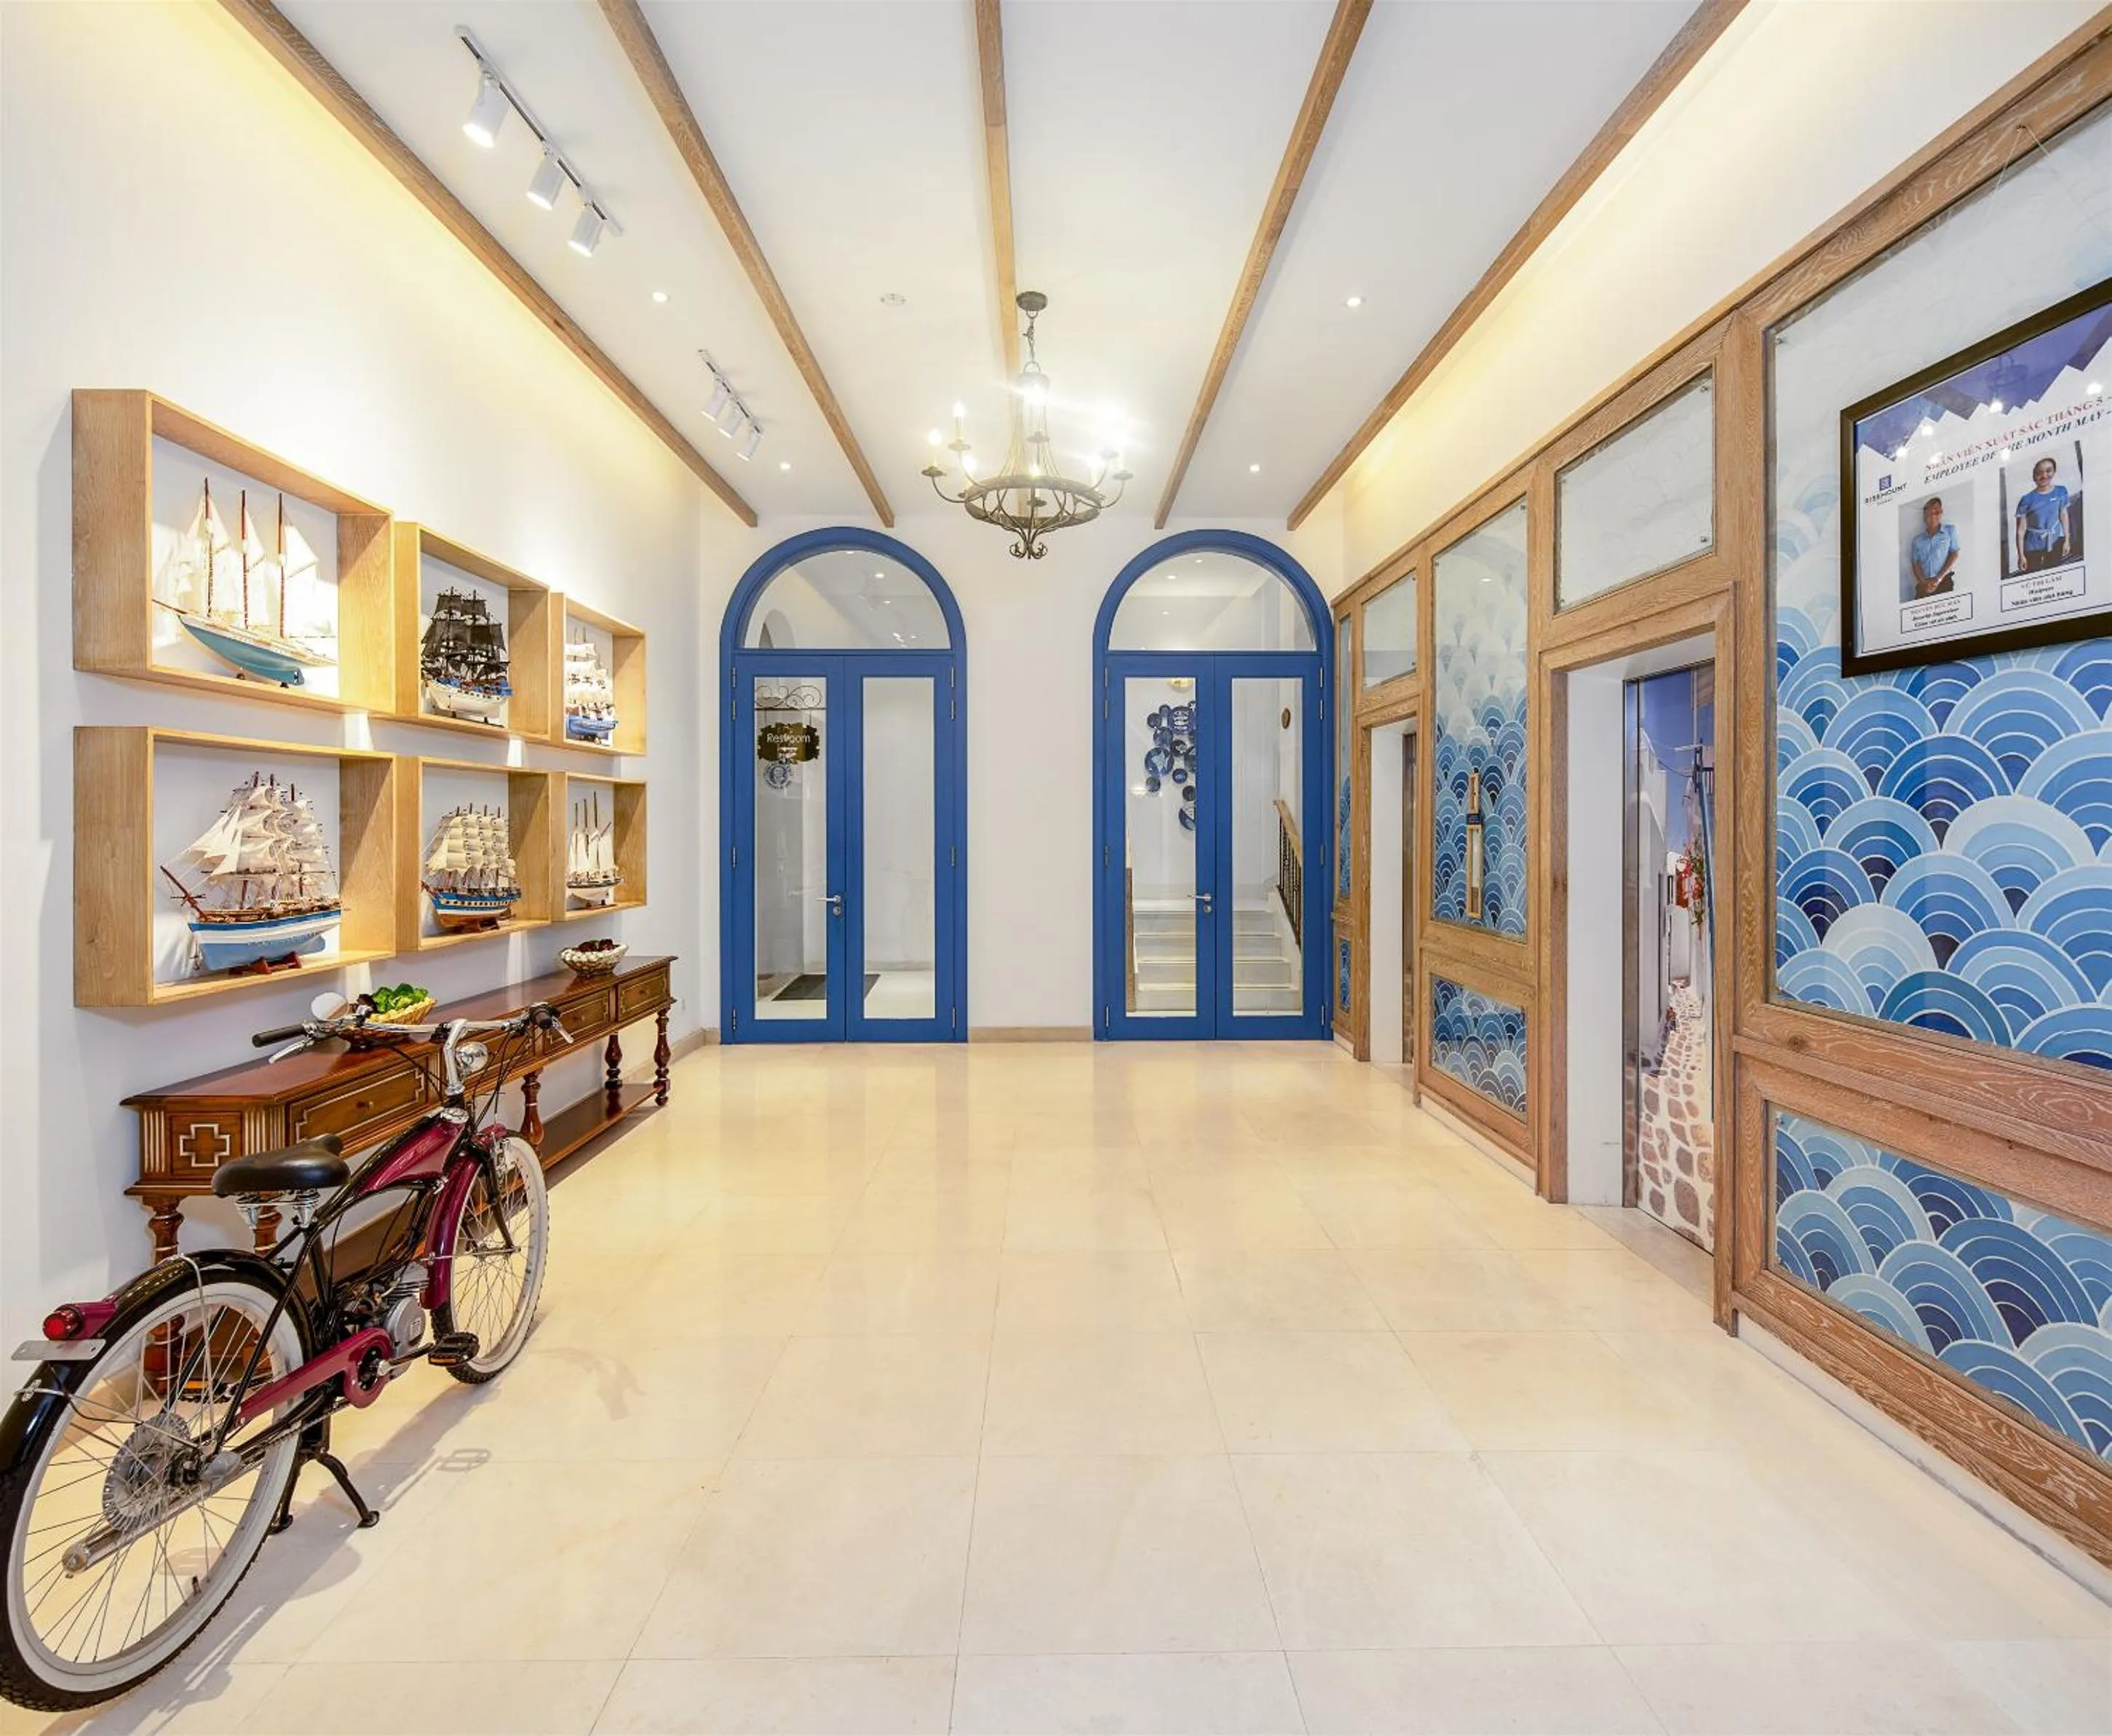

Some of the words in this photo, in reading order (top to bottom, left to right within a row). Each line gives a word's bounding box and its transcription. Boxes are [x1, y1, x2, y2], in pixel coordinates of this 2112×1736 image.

[1924, 457, 1980, 485] EMPLOYEE
[2025, 420, 2073, 445] MONTH
[2073, 408, 2105, 429] MAY
